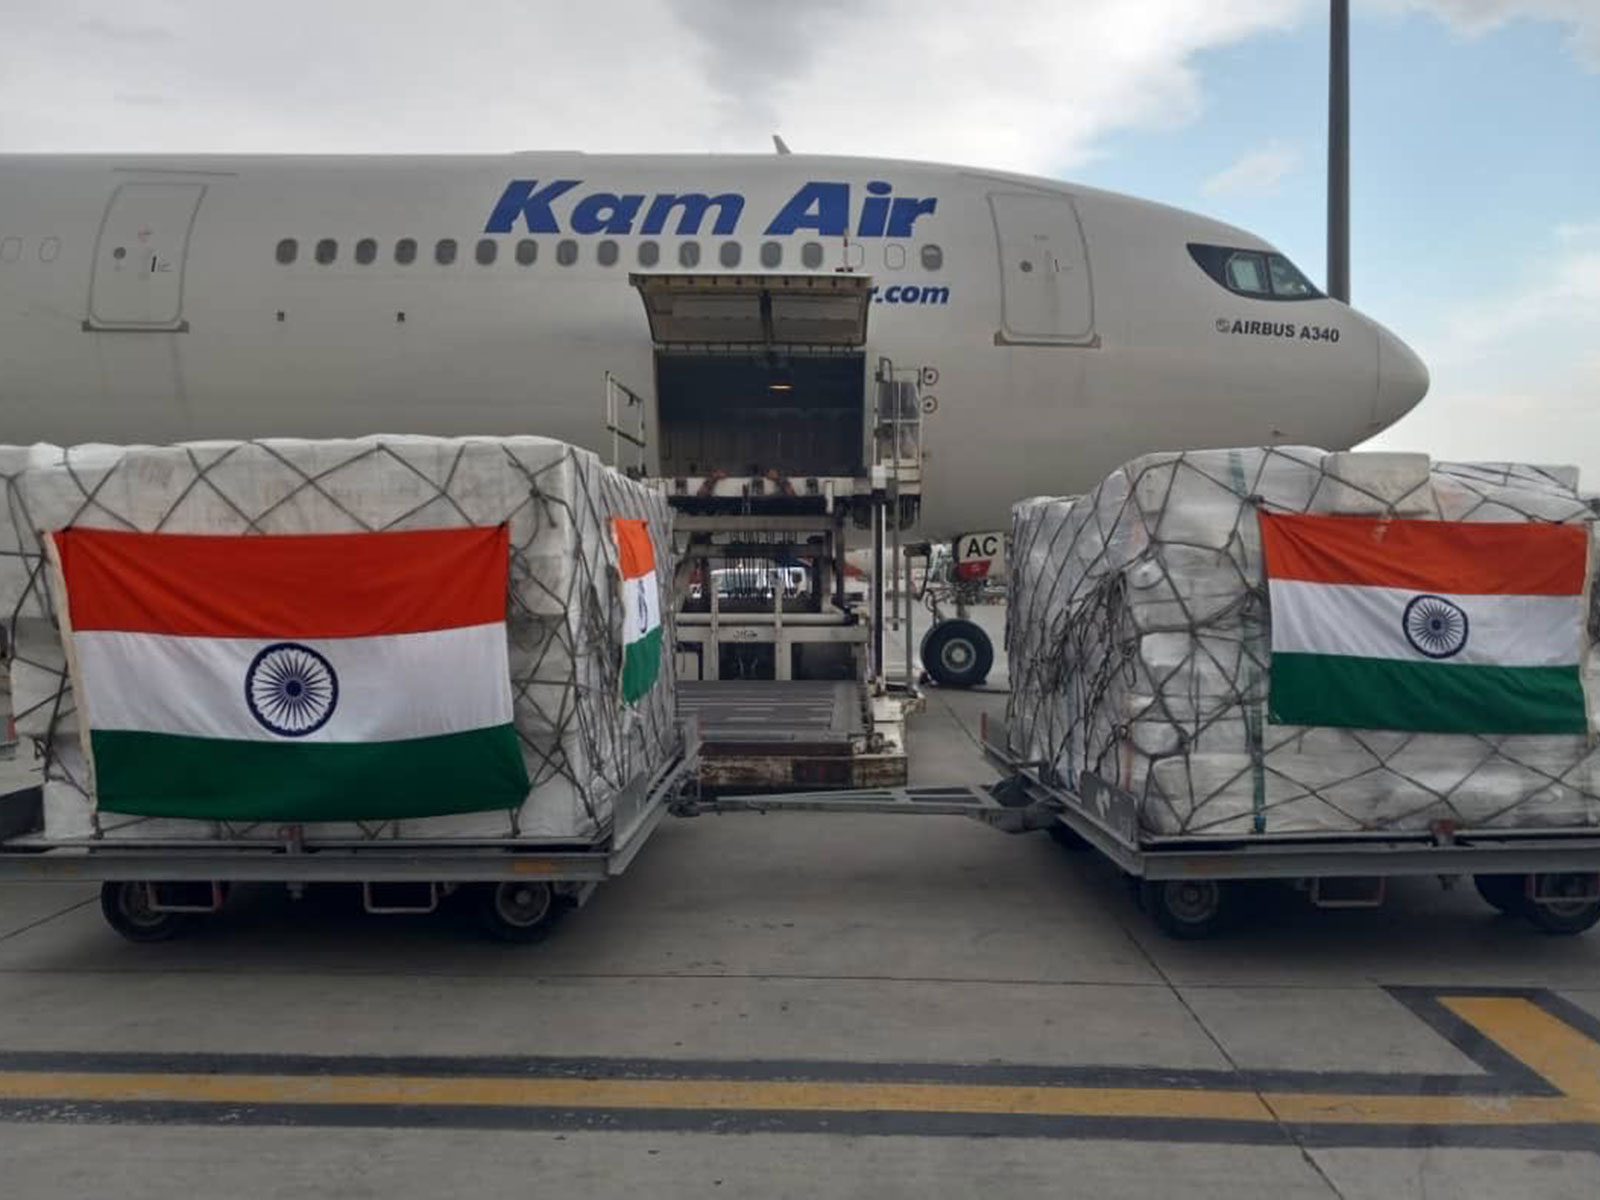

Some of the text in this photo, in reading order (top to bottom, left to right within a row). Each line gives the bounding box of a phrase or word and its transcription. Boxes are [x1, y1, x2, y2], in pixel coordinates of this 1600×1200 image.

[484, 179, 937, 238] Kam Air
[1231, 320, 1340, 342] AIRBUS A340
[966, 536, 998, 557] AC
